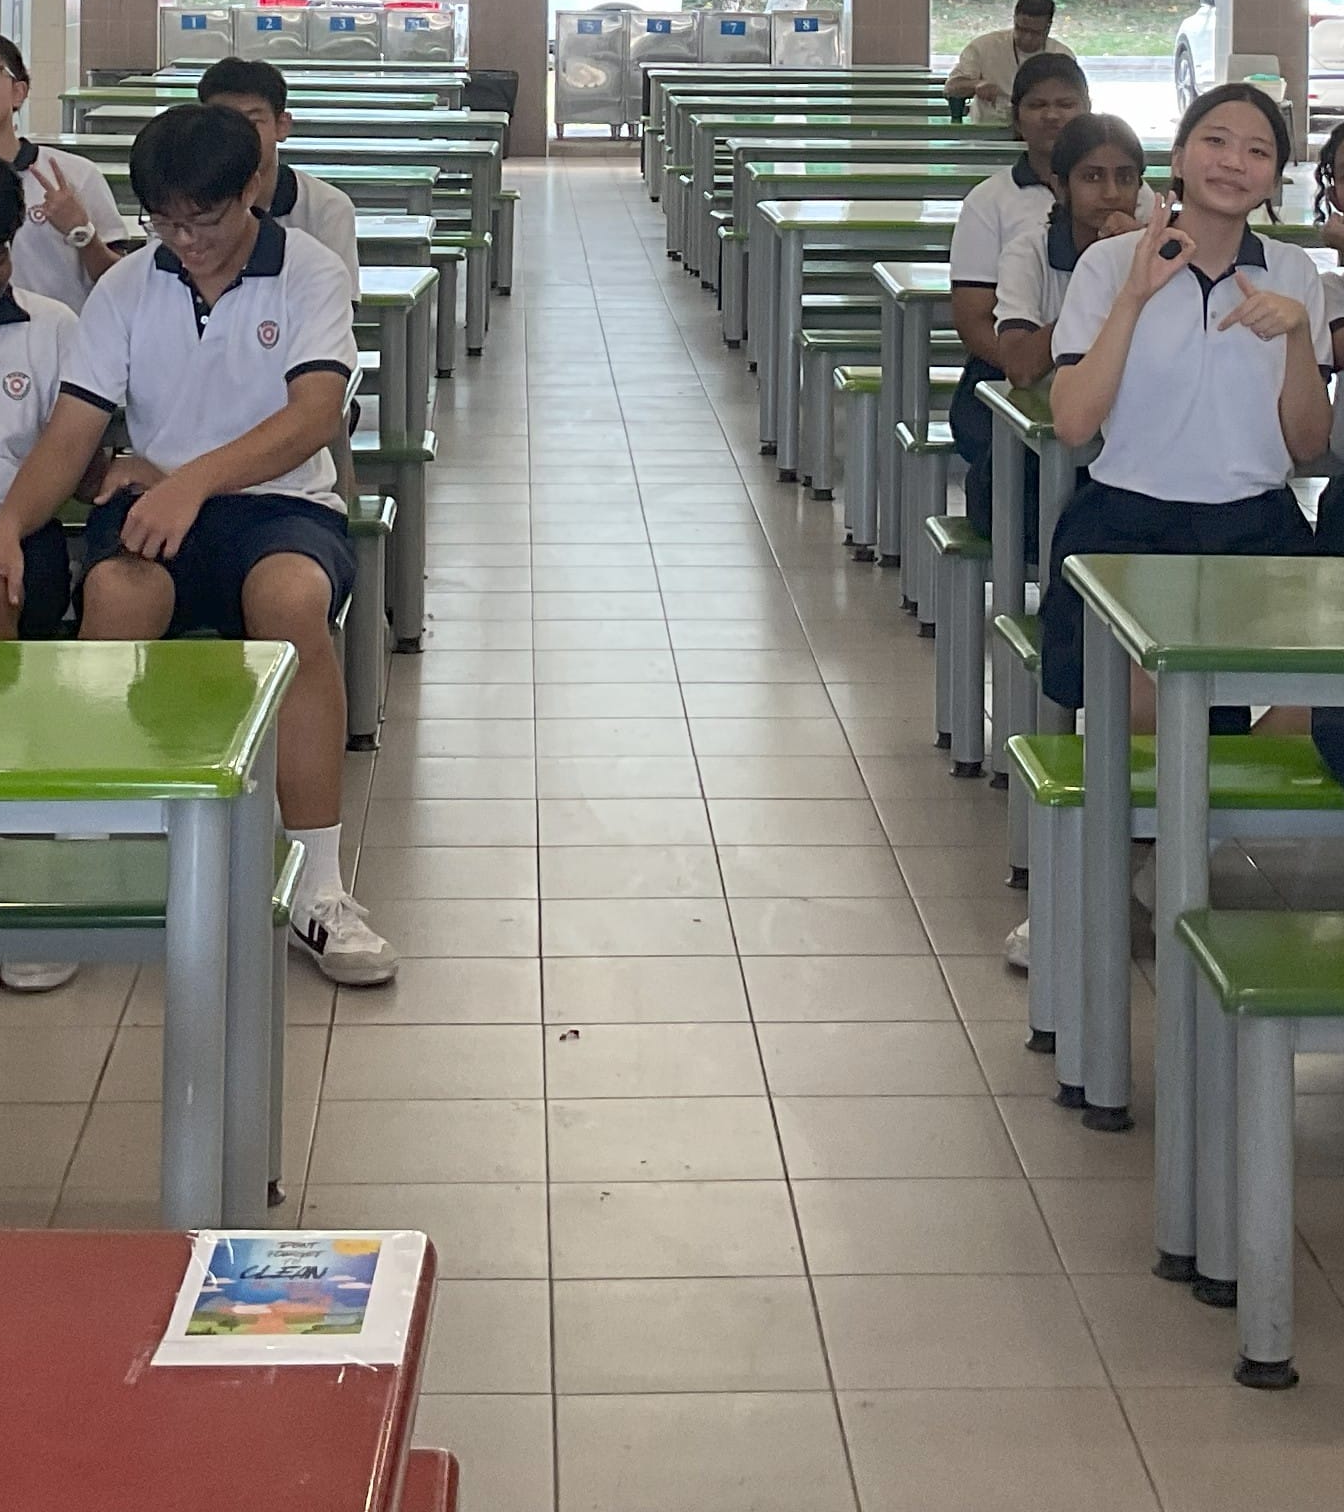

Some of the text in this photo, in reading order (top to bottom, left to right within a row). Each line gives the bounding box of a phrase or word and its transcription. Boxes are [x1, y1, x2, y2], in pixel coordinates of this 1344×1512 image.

[191, 16, 197, 28] 1
[265, 17, 273, 29] 2
[339, 18, 347, 30] 3
[655, 20, 663, 33] 6
[729, 22, 737, 34] 7
[802, 18, 810, 31] 8
[240, 1265, 329, 1280] CLEAN
